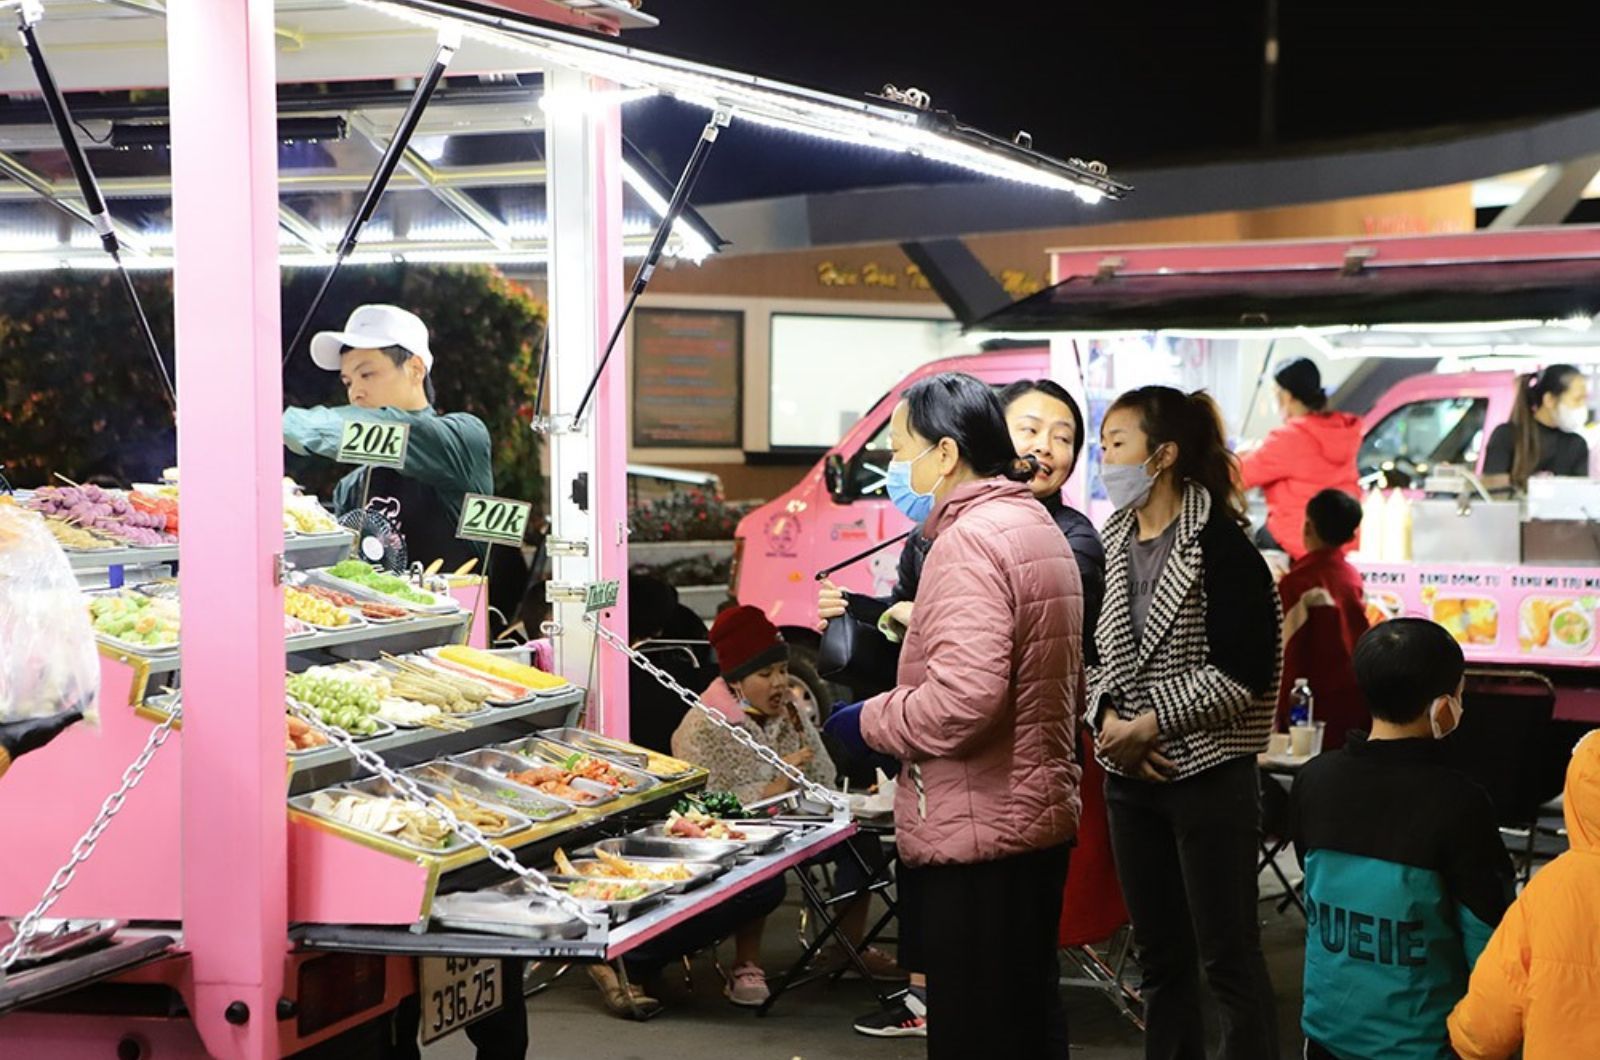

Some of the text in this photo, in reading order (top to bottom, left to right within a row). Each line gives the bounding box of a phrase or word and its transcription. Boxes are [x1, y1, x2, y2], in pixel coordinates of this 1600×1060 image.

[343, 422, 401, 455] 20k
[465, 500, 525, 534] 20k
[432, 966, 495, 1033] 336.25
